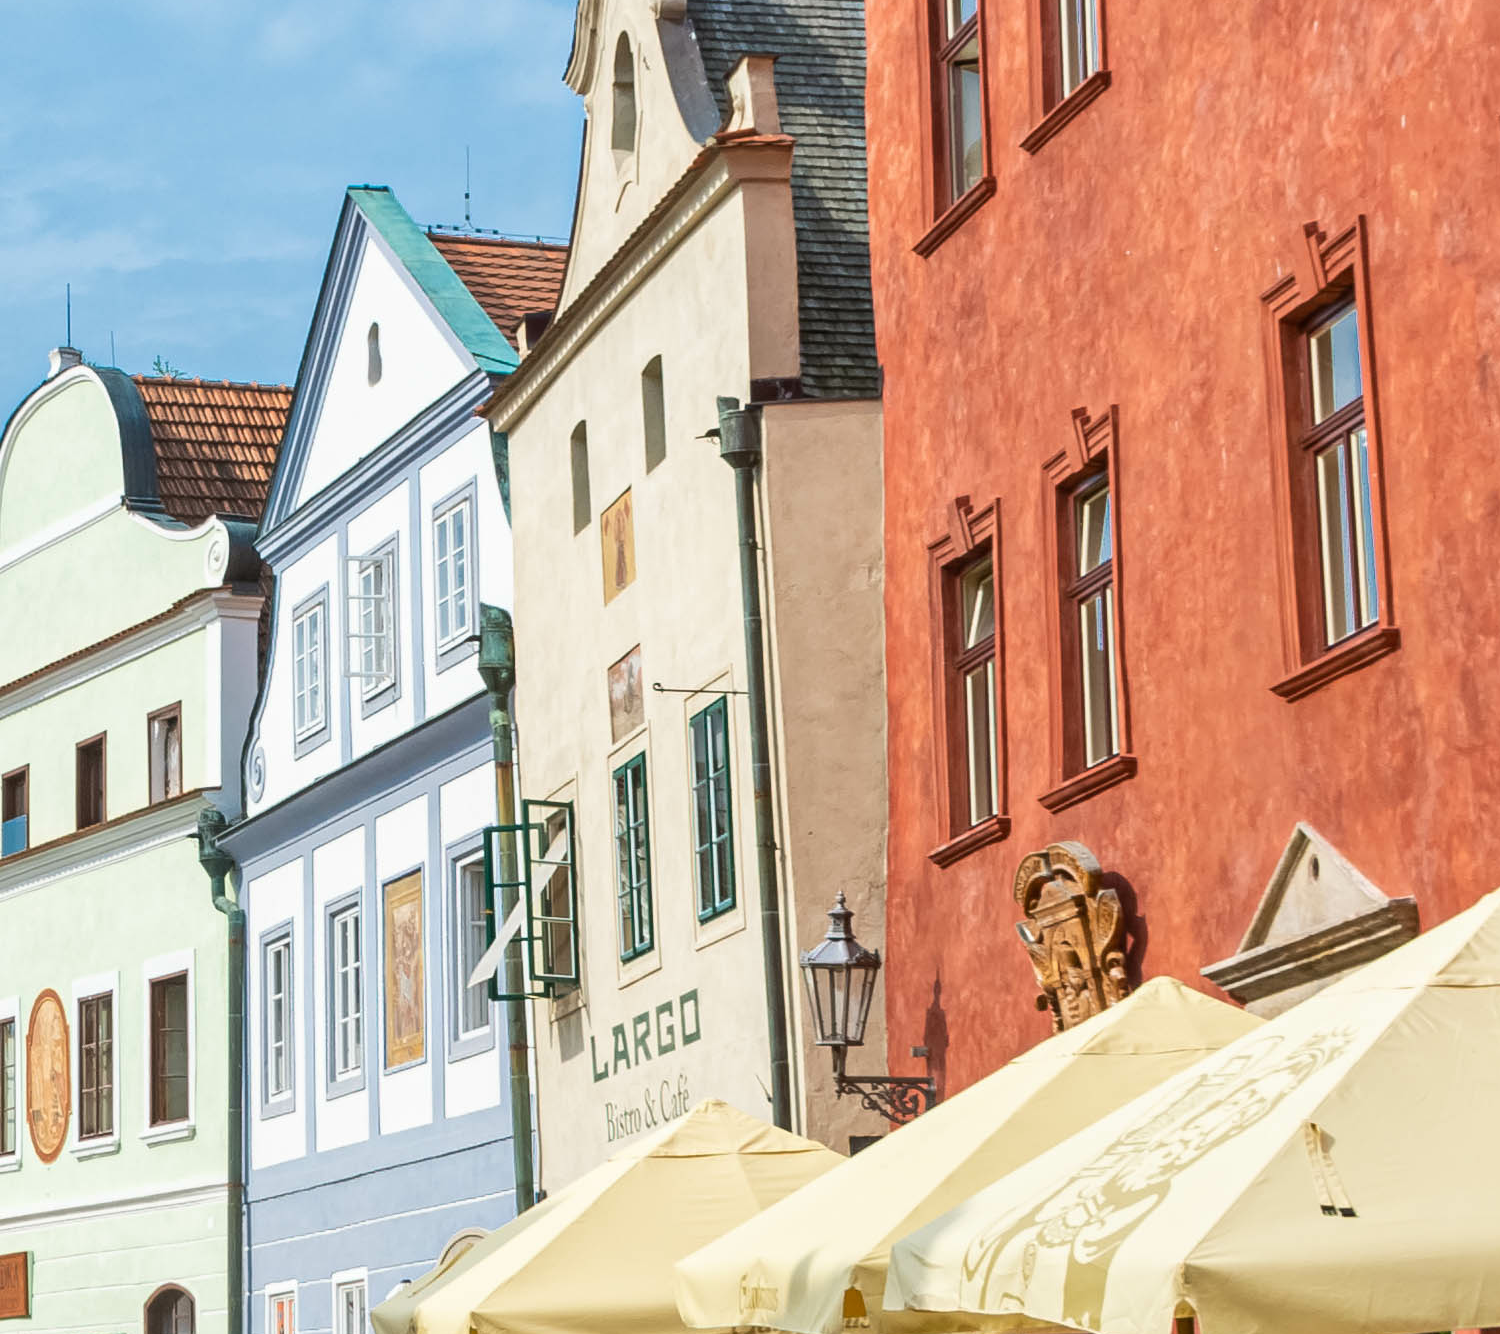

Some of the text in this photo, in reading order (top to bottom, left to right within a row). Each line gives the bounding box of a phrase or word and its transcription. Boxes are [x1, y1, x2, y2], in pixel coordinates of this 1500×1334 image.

[590, 988, 702, 1083] LARGO
[605, 1073, 690, 1143] Bistro & Café
